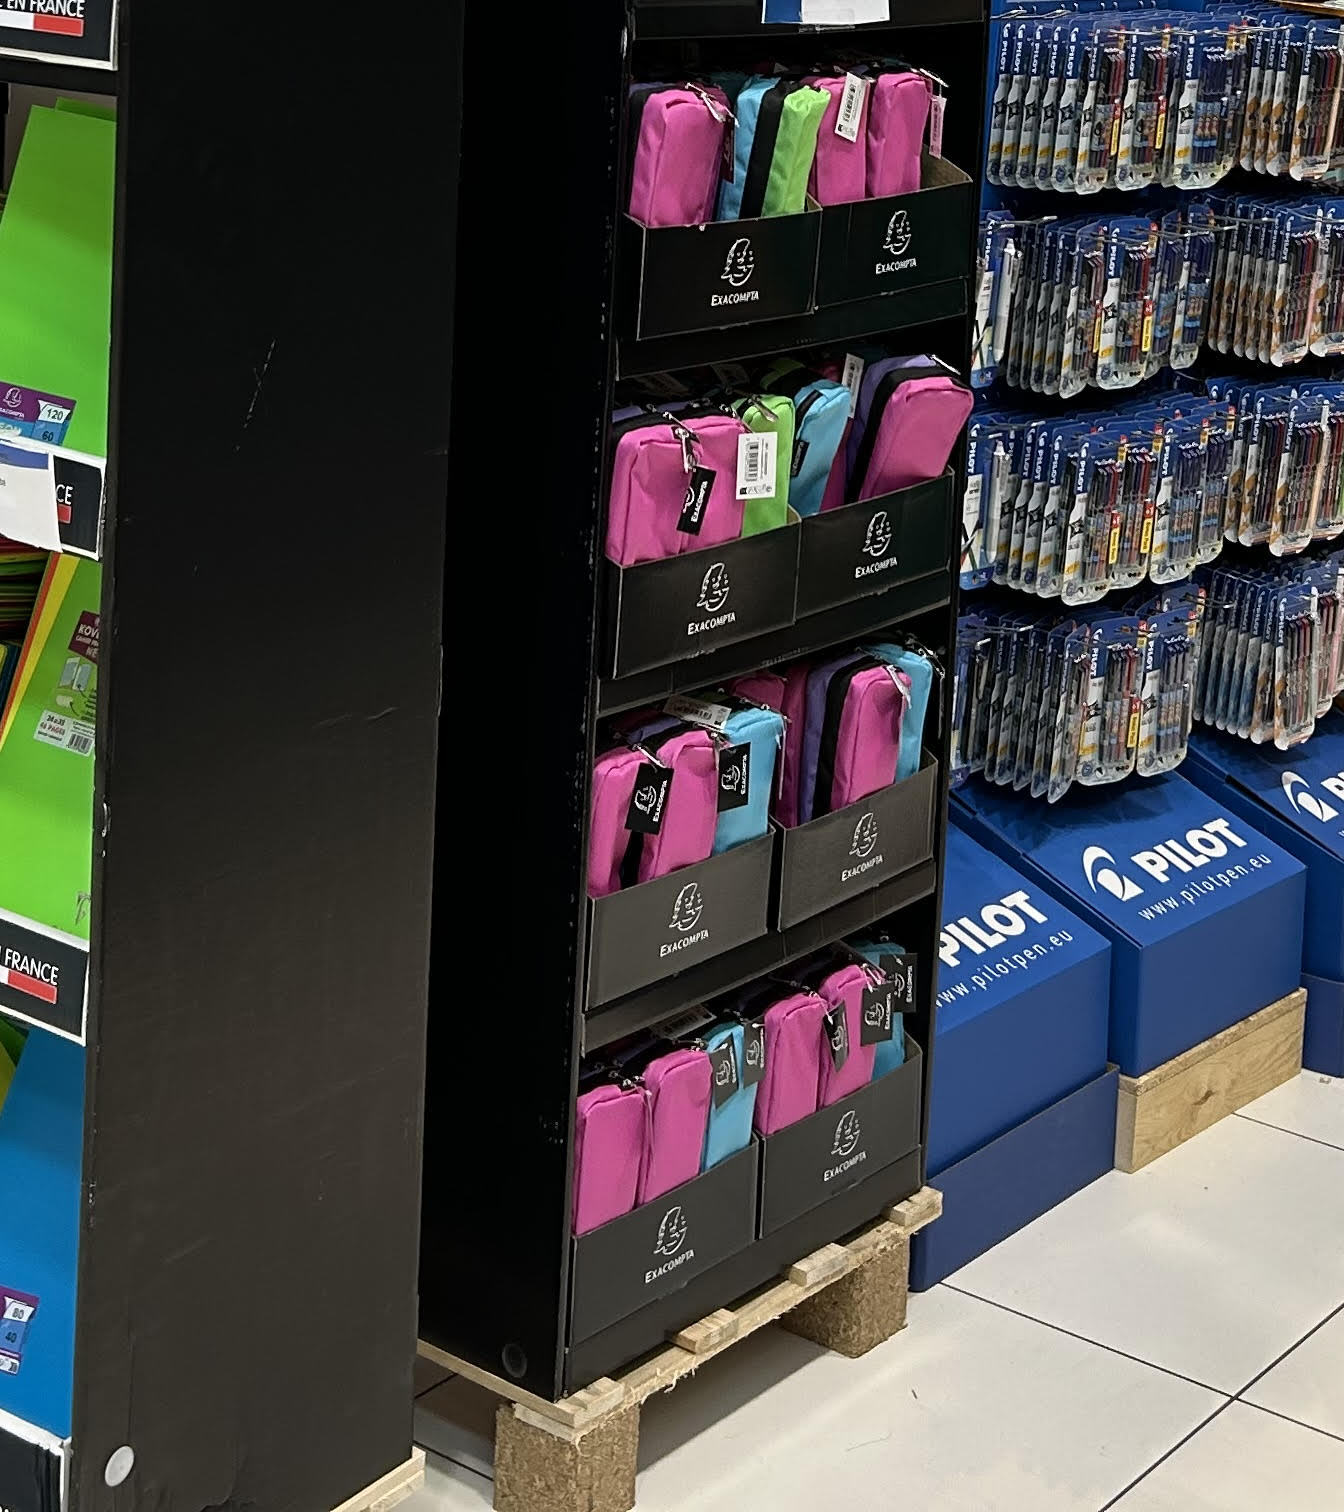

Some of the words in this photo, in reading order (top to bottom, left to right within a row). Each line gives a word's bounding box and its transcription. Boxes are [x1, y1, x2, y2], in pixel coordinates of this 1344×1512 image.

[875, 257, 918, 276] EXACOMPTA
[710, 289, 760, 308] EXACOMPTA
[46, 408, 64, 422] 120
[41, 430, 54, 443] 60
[967, 441, 977, 475] PILOT
[1076, 461, 1087, 492] PILOT
[854, 554, 899, 580] EXACOMPTA
[687, 610, 737, 637] EXACOMPTA
[653, 778, 669, 824] EXACOMPTA
[1129, 816, 1251, 887] PILOT
[840, 853, 885, 882] EXACOMPTA
[1136, 849, 1273, 923] www.pilotpen.eu
[658, 927, 710, 959] EXACOMPTA
[937, 888, 1049, 970] PILOT
[5, 948, 60, 990] FRANCE
[822, 1148, 868, 1182] EXACOMPTA
[644, 1246, 696, 1285] EXACOMPTA
[4, 1330, 18, 1344] 40
